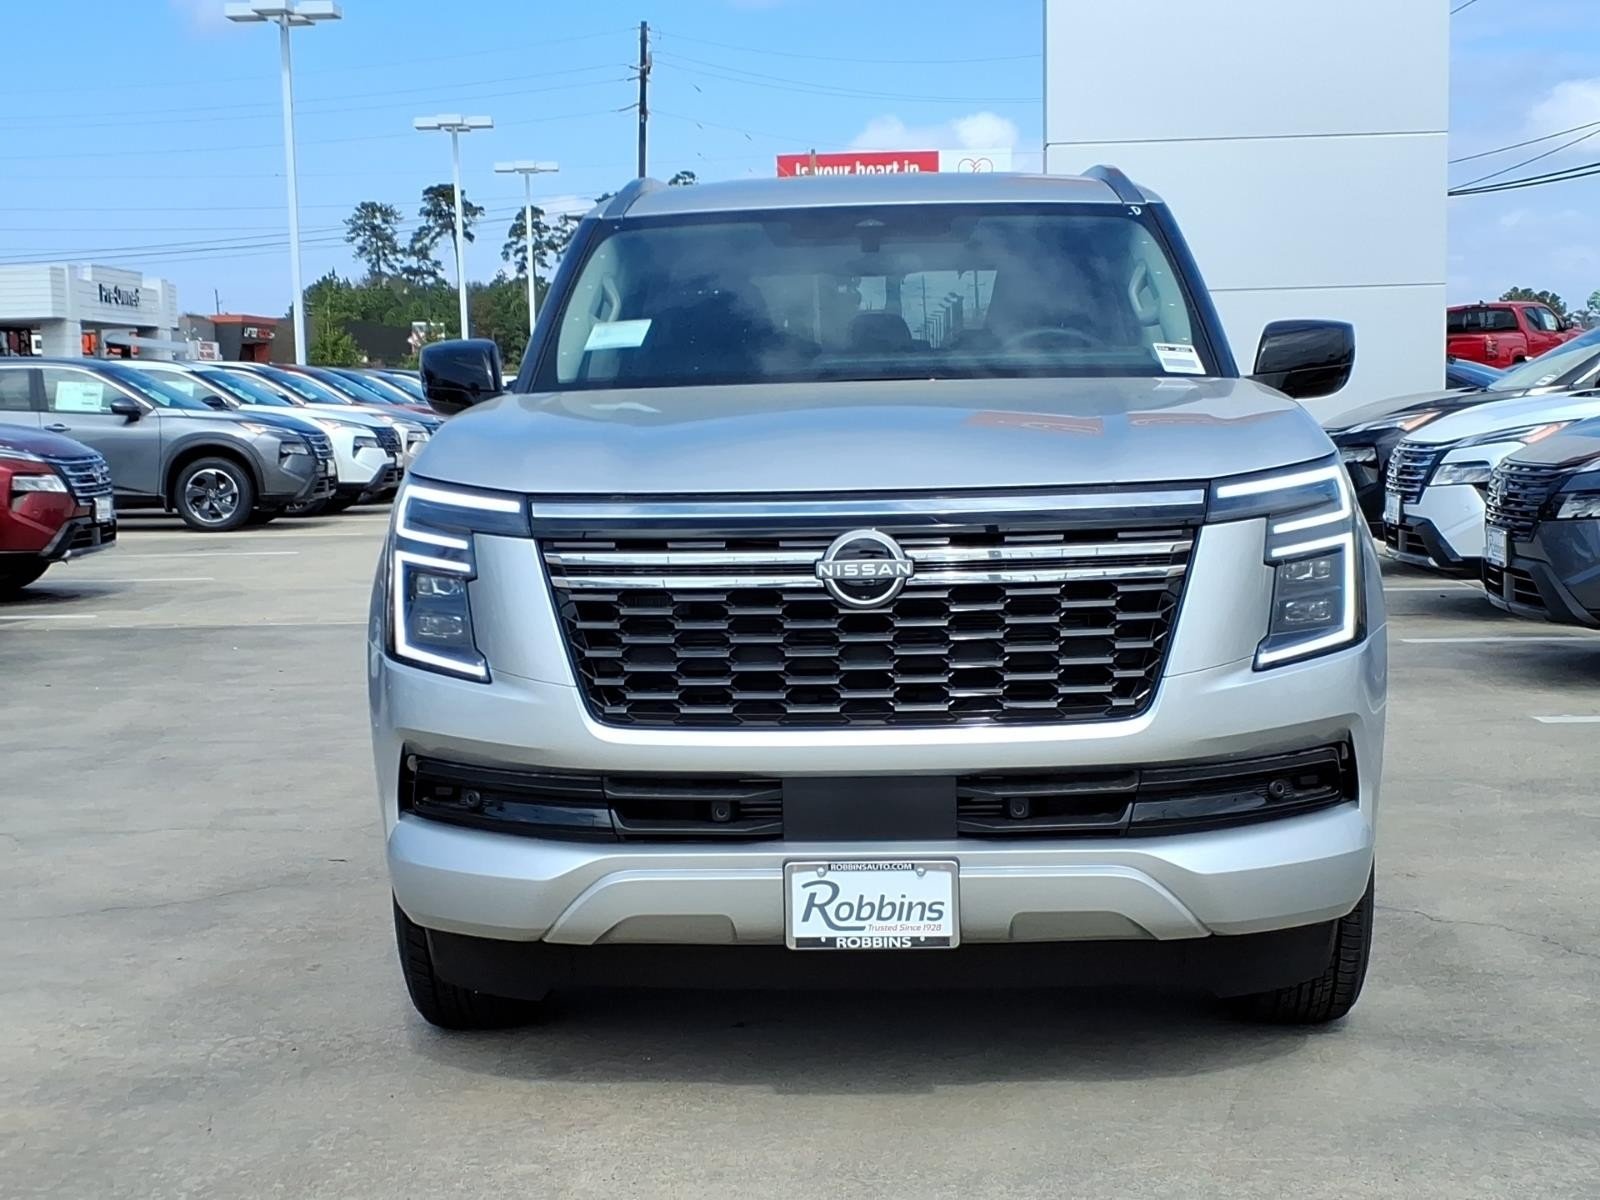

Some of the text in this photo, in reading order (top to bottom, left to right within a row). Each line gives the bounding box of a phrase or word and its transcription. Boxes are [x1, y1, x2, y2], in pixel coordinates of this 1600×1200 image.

[795, 162, 809, 176] Is
[814, 164, 852, 175] your
[904, 159, 920, 174] in
[818, 562, 911, 576] NISSAN
[801, 880, 945, 931] Robbins
[868, 924, 942, 932] Trusted Since 1928
[836, 936, 912, 949] ROBBINS
